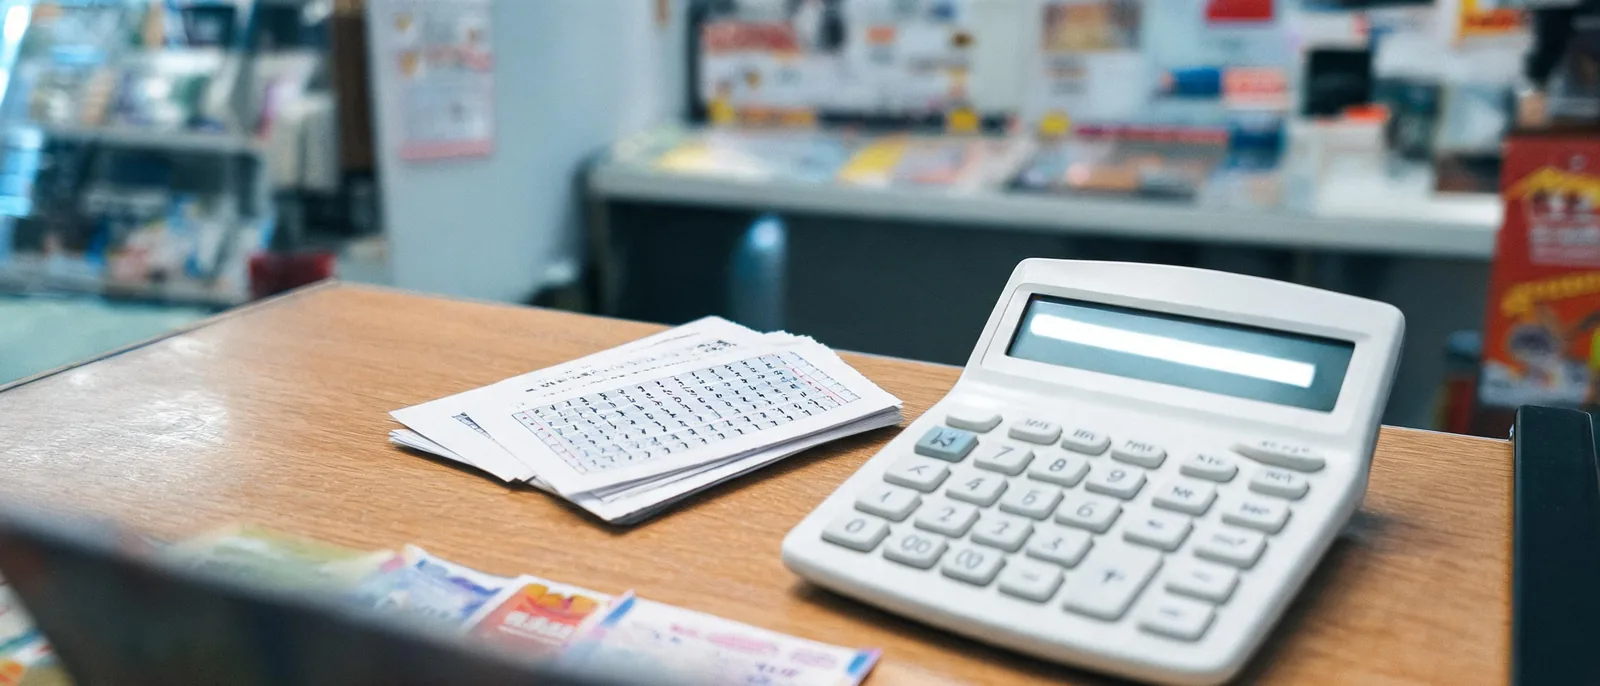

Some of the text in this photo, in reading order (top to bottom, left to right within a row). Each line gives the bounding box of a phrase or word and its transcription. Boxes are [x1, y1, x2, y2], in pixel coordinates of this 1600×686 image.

[1049, 458, 1067, 472] 8
[1107, 469, 1127, 483] 9
[1077, 502, 1098, 517] 6
[845, 518, 866, 534] 0
[901, 534, 932, 554] 00
